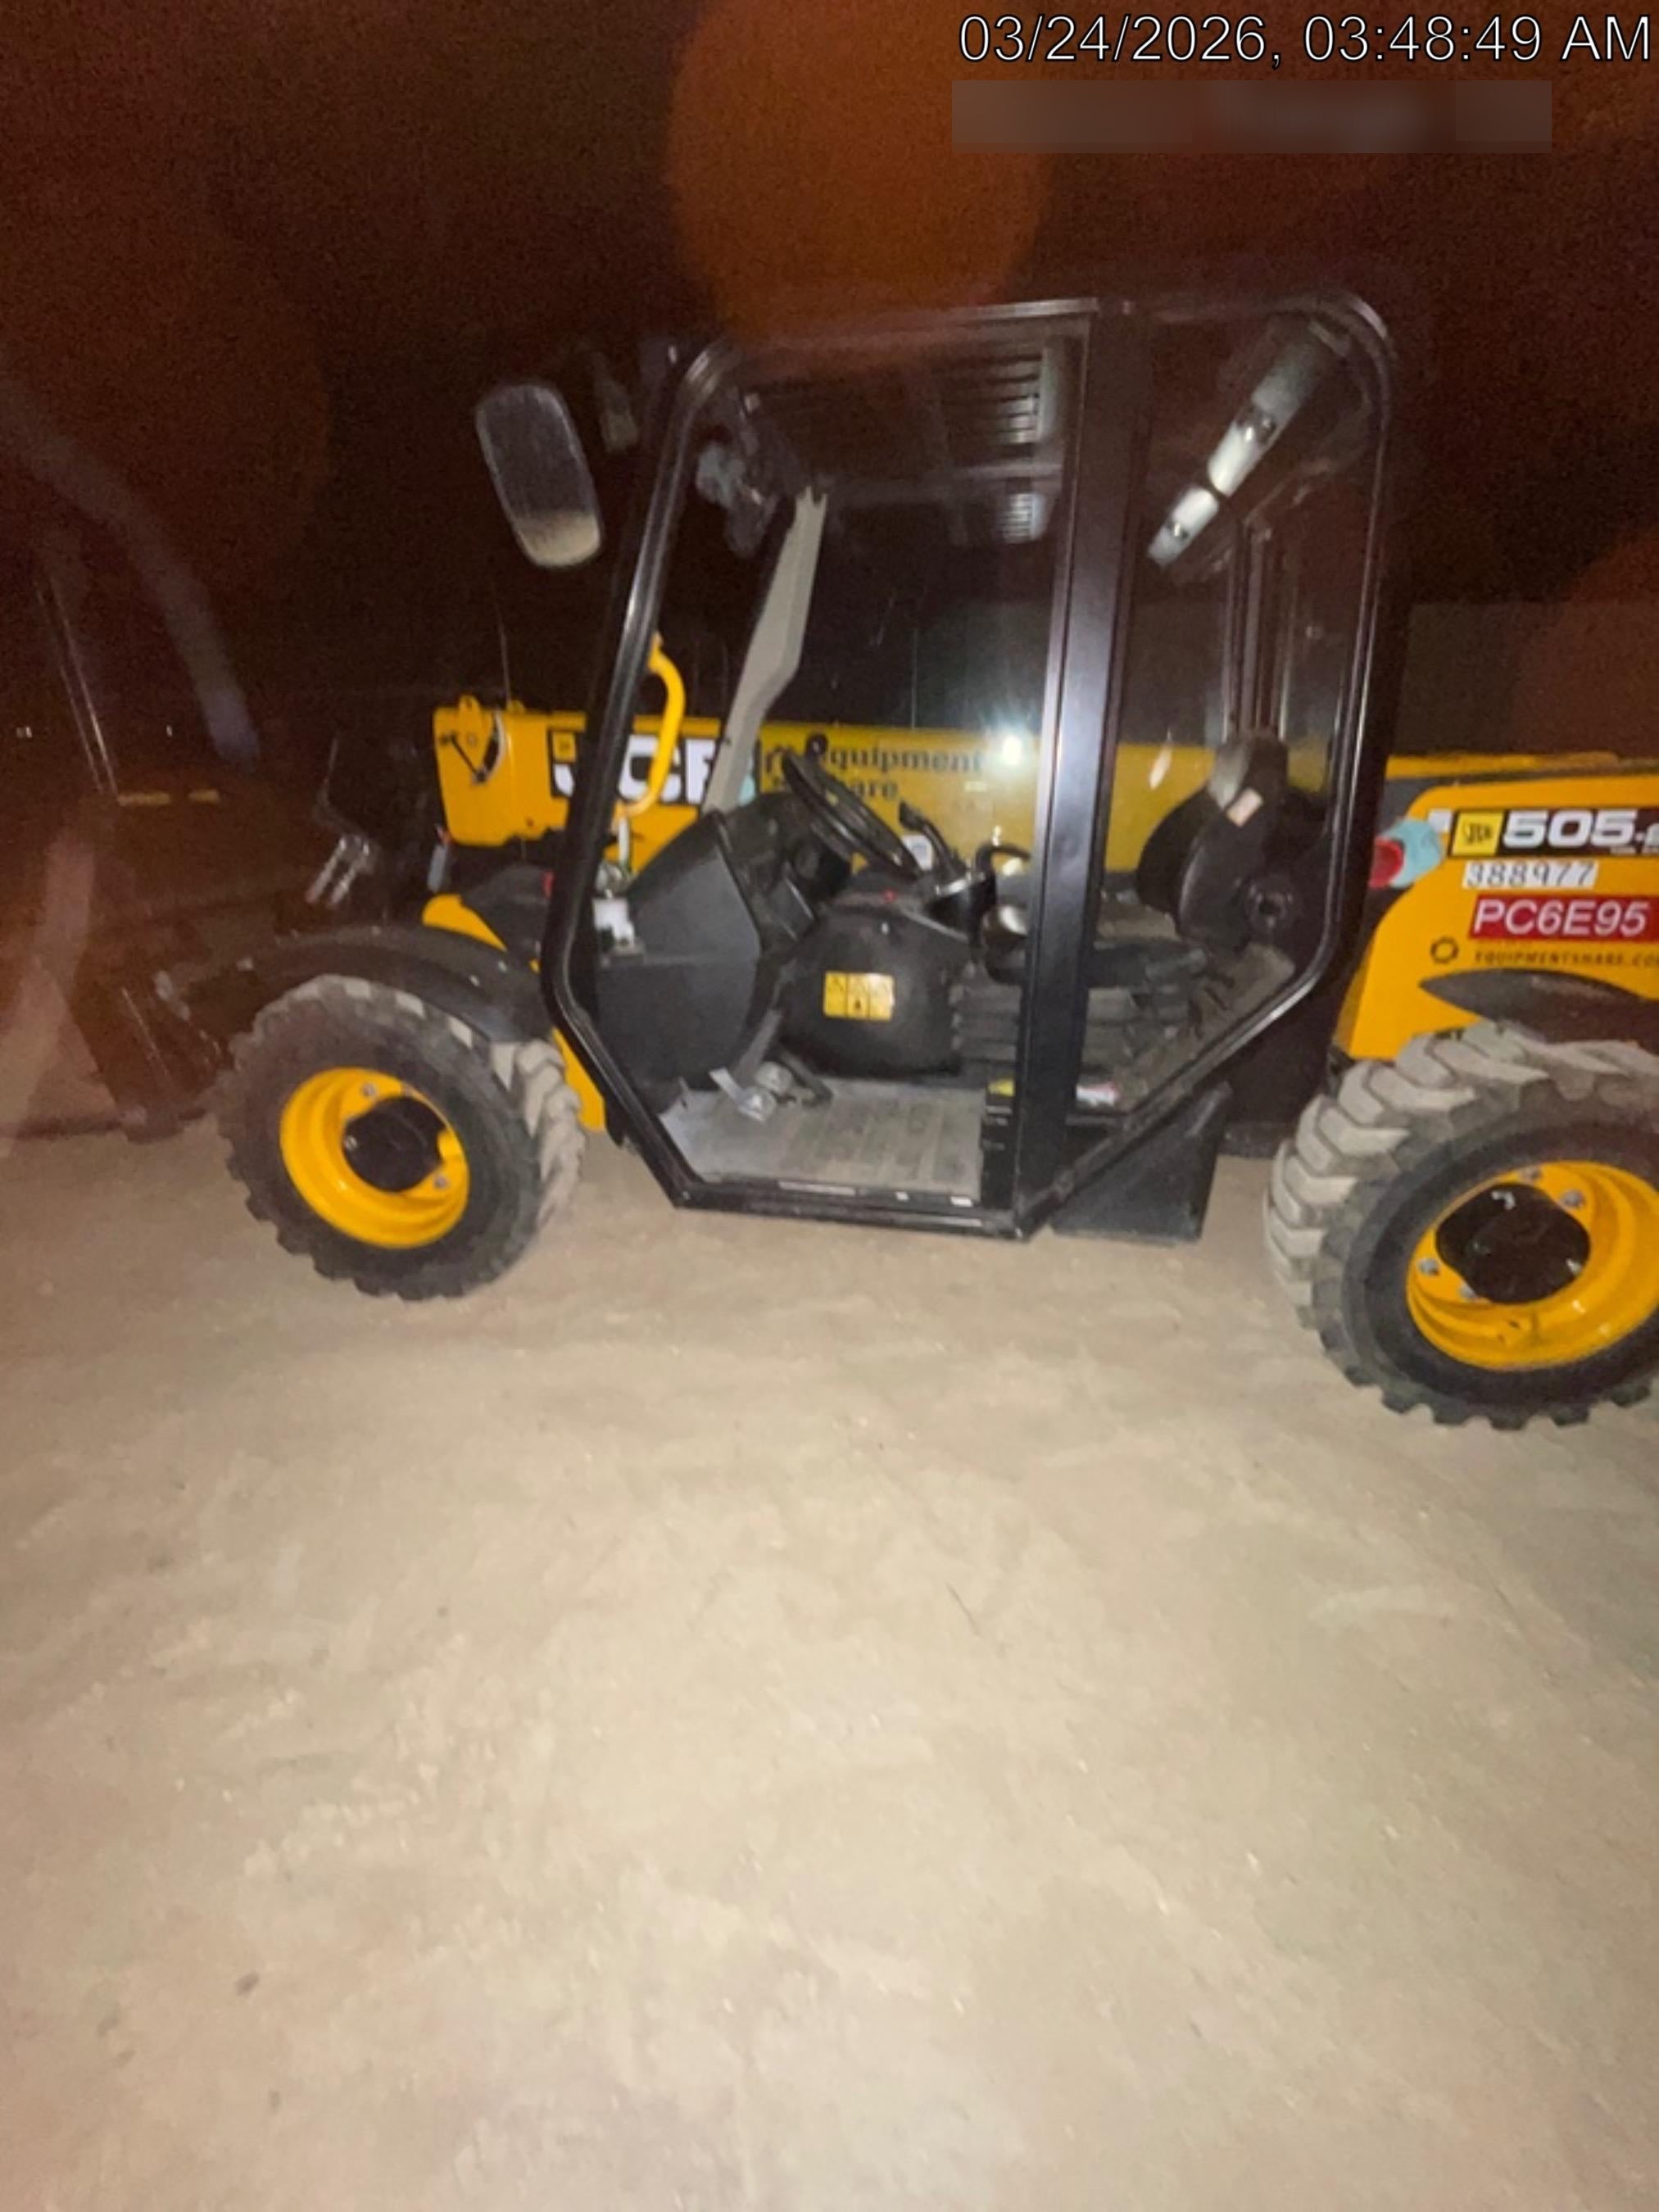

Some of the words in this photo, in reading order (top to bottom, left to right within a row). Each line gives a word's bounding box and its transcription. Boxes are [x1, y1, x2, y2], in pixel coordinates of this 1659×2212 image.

[828, 744, 984, 774] quipment
[1466, 861, 1594, 886] 388977
[1473, 898, 1651, 936] PC6E95
